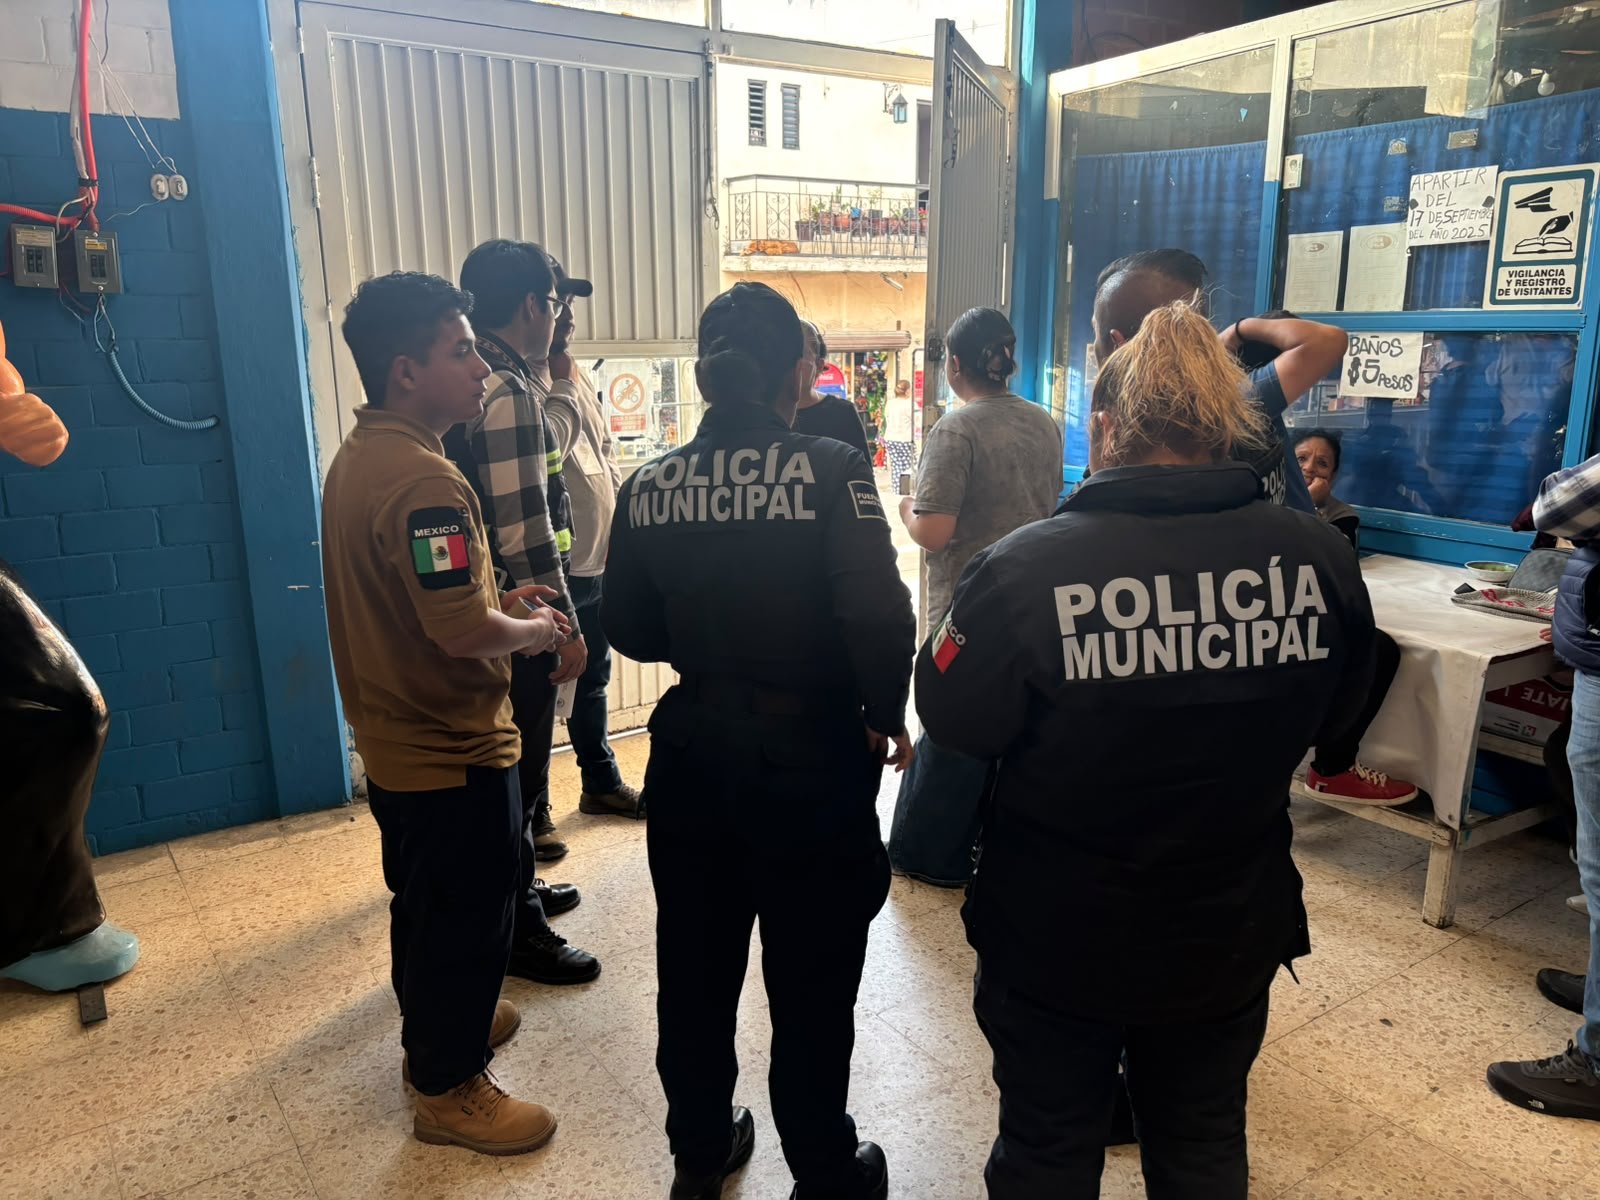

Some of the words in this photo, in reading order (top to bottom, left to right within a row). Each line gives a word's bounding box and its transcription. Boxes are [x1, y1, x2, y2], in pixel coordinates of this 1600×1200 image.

[1426, 191, 1456, 208] DEL
[1410, 210, 1424, 227] 17
[1409, 229, 1424, 239] DEL
[1429, 228, 1449, 239] AÑO
[1451, 223, 1489, 239] 2025
[1508, 268, 1565, 278] VIGILANCIA
[1506, 279, 1512, 287] Y
[1515, 277, 1566, 287] REGISTRO
[1497, 288, 1511, 296] DE
[1514, 287, 1572, 296] VISITANTES
[1348, 335, 1404, 358] BAÑOS
[631, 441, 817, 496] POLICÍA
[628, 484, 817, 528] MUNICIPAL
[414, 525, 459, 537] MEXICO
[1053, 555, 1328, 636] POLICÍA
[1062, 616, 1331, 681] MUNICIPAL
